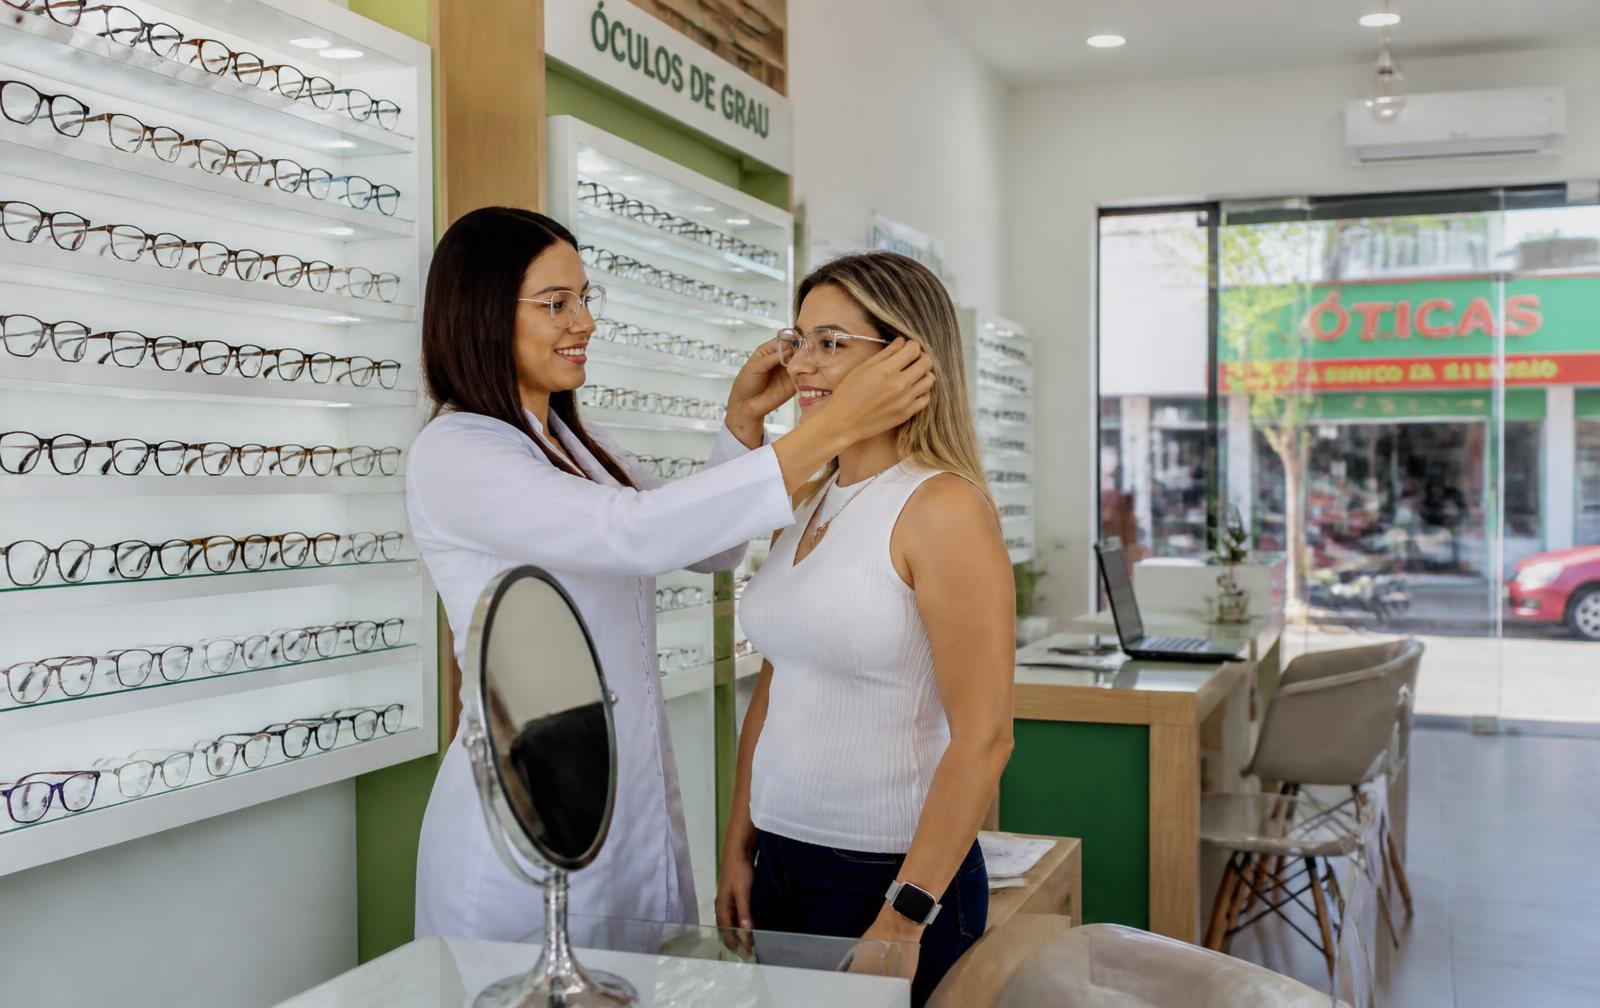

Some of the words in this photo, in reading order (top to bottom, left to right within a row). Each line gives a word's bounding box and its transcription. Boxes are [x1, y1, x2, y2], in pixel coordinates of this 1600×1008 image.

[591, 0, 684, 93] ÓCULOS
[690, 65, 716, 112] DE
[721, 84, 769, 139] GRAU
[1310, 290, 1543, 341] ÓTICAS
